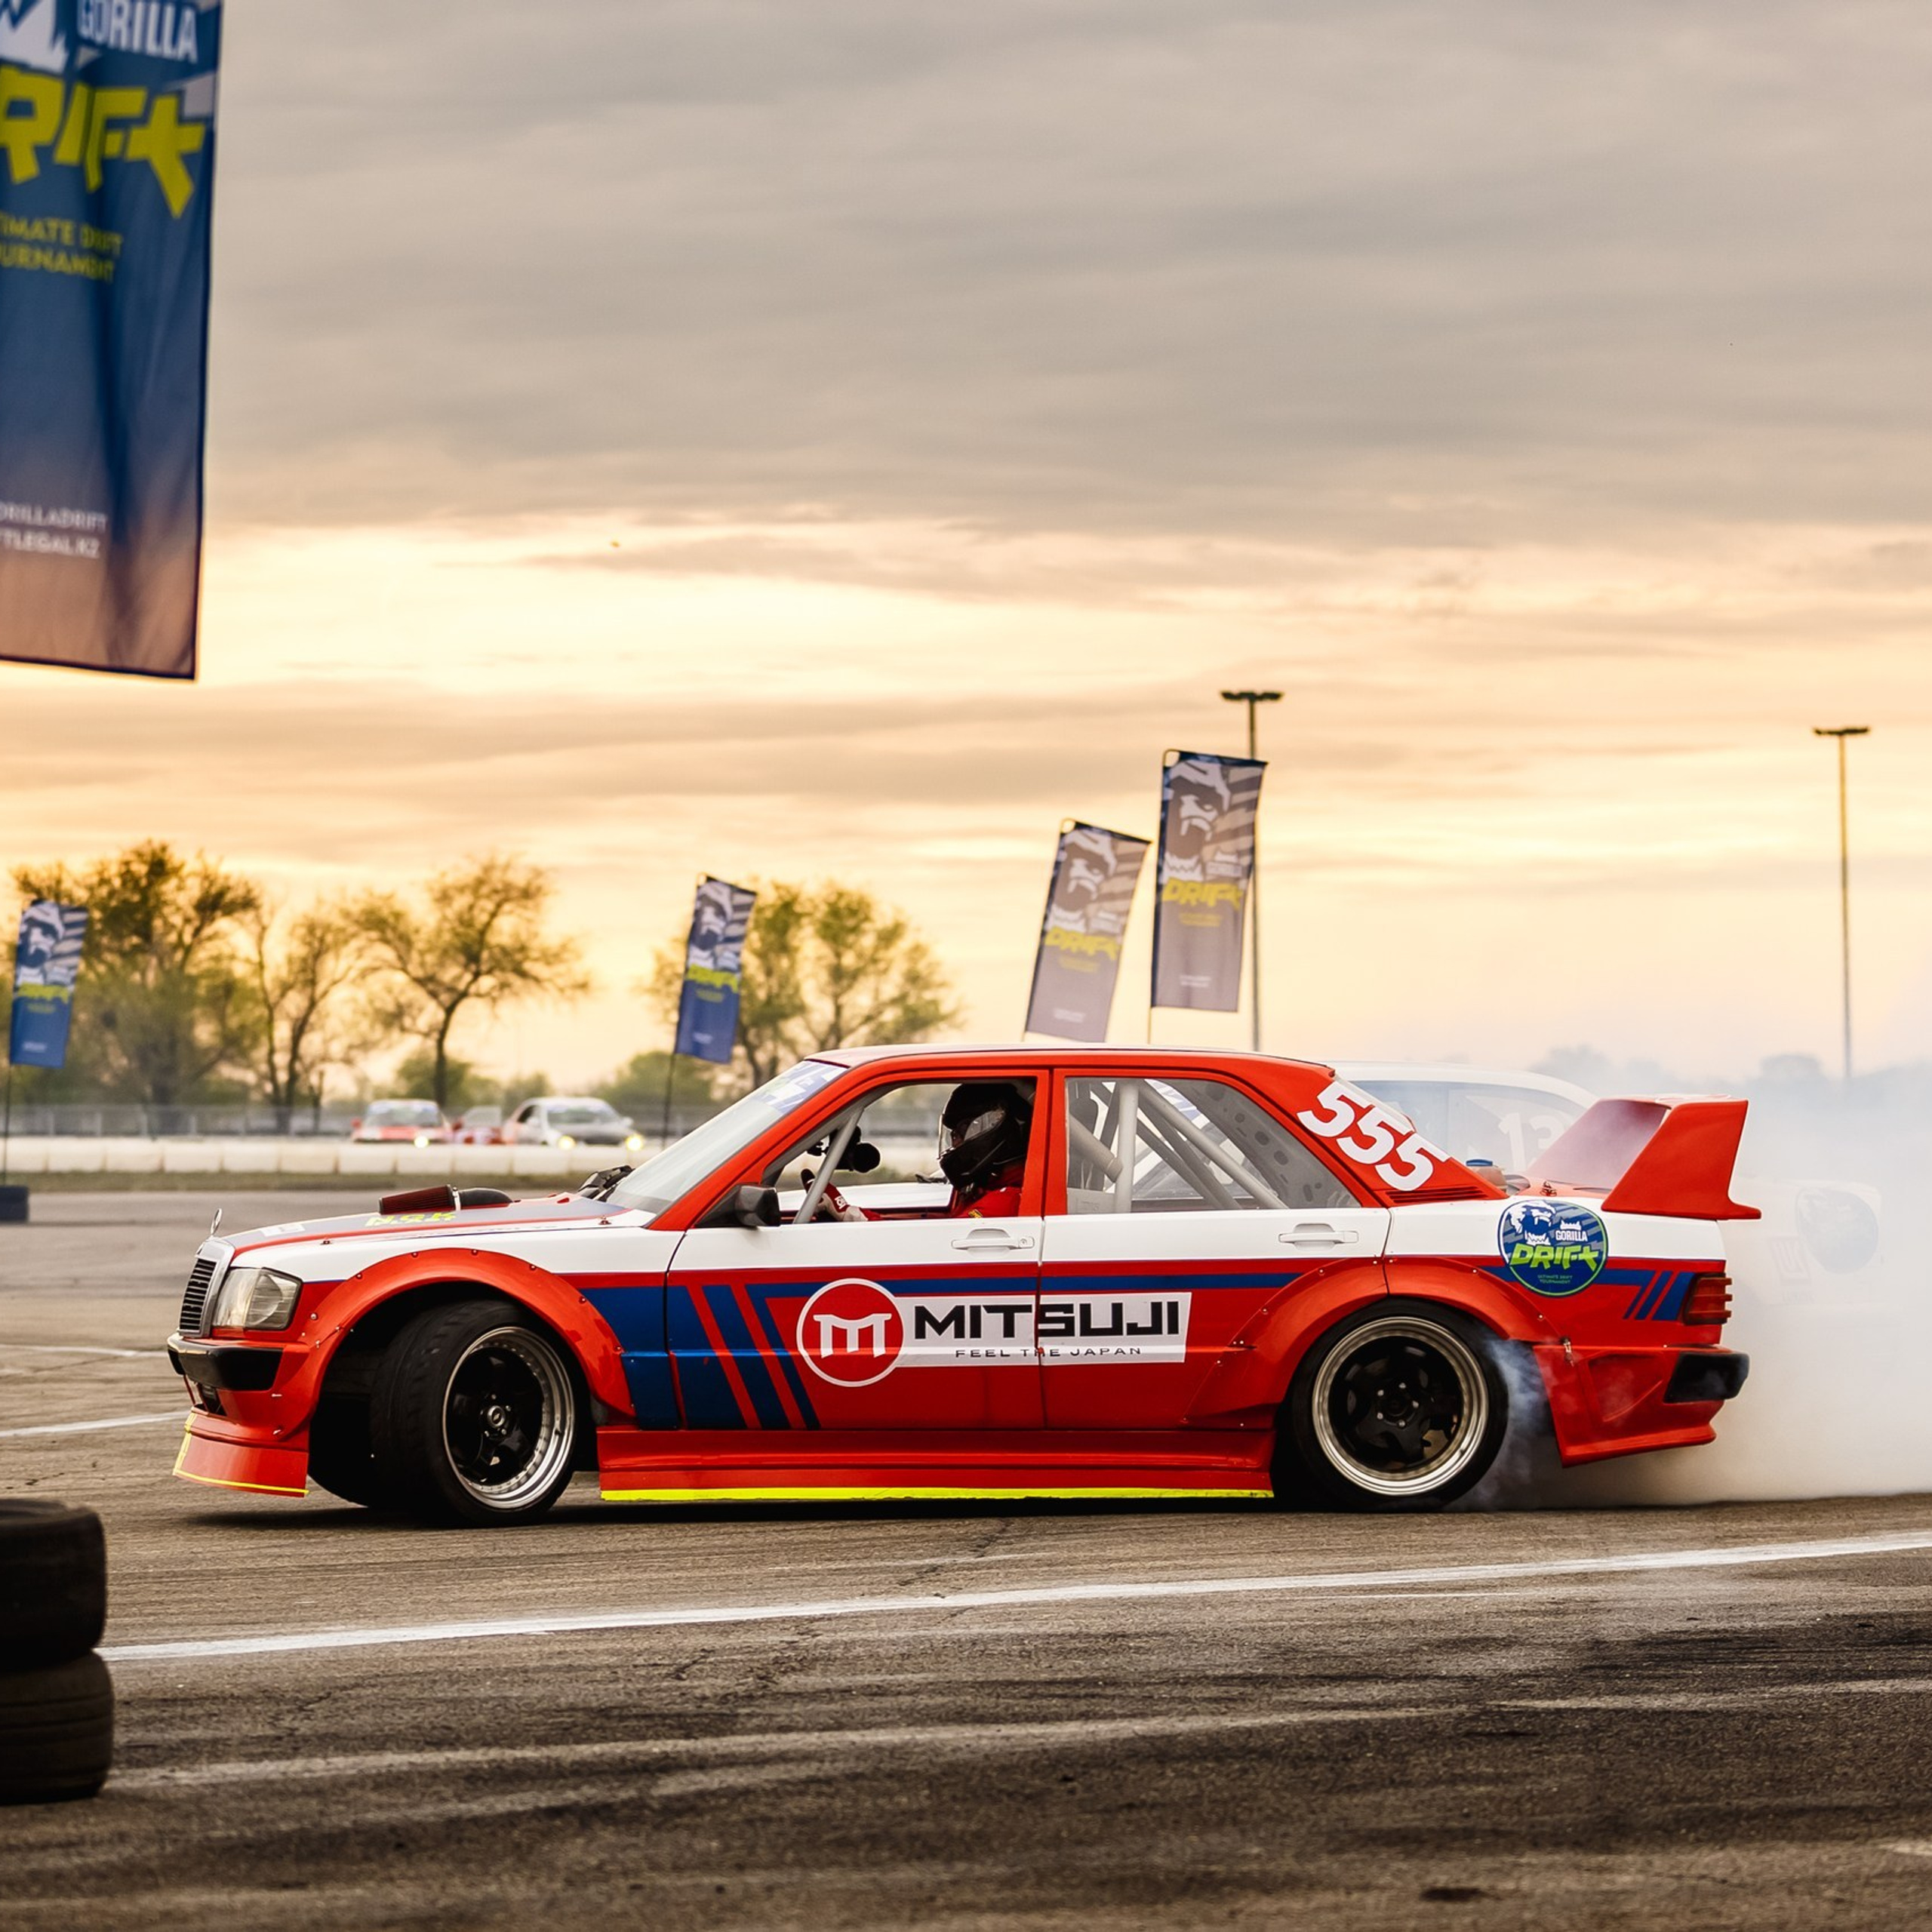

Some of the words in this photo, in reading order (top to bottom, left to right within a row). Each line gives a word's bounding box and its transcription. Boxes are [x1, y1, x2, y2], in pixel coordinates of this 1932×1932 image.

[78, 0, 198, 63] GORILLA
[1161, 876, 1244, 911] DRIFT
[1297, 1081, 1452, 1192] 555
[1555, 1230, 1588, 1241] GORILLA
[1510, 1243, 1599, 1272] DRIFT
[914, 1300, 1180, 1340] MITSUJI
[955, 1349, 1011, 1358] FEEL
[1020, 1349, 1060, 1358] THE
[1070, 1347, 1141, 1357] JAPAN
